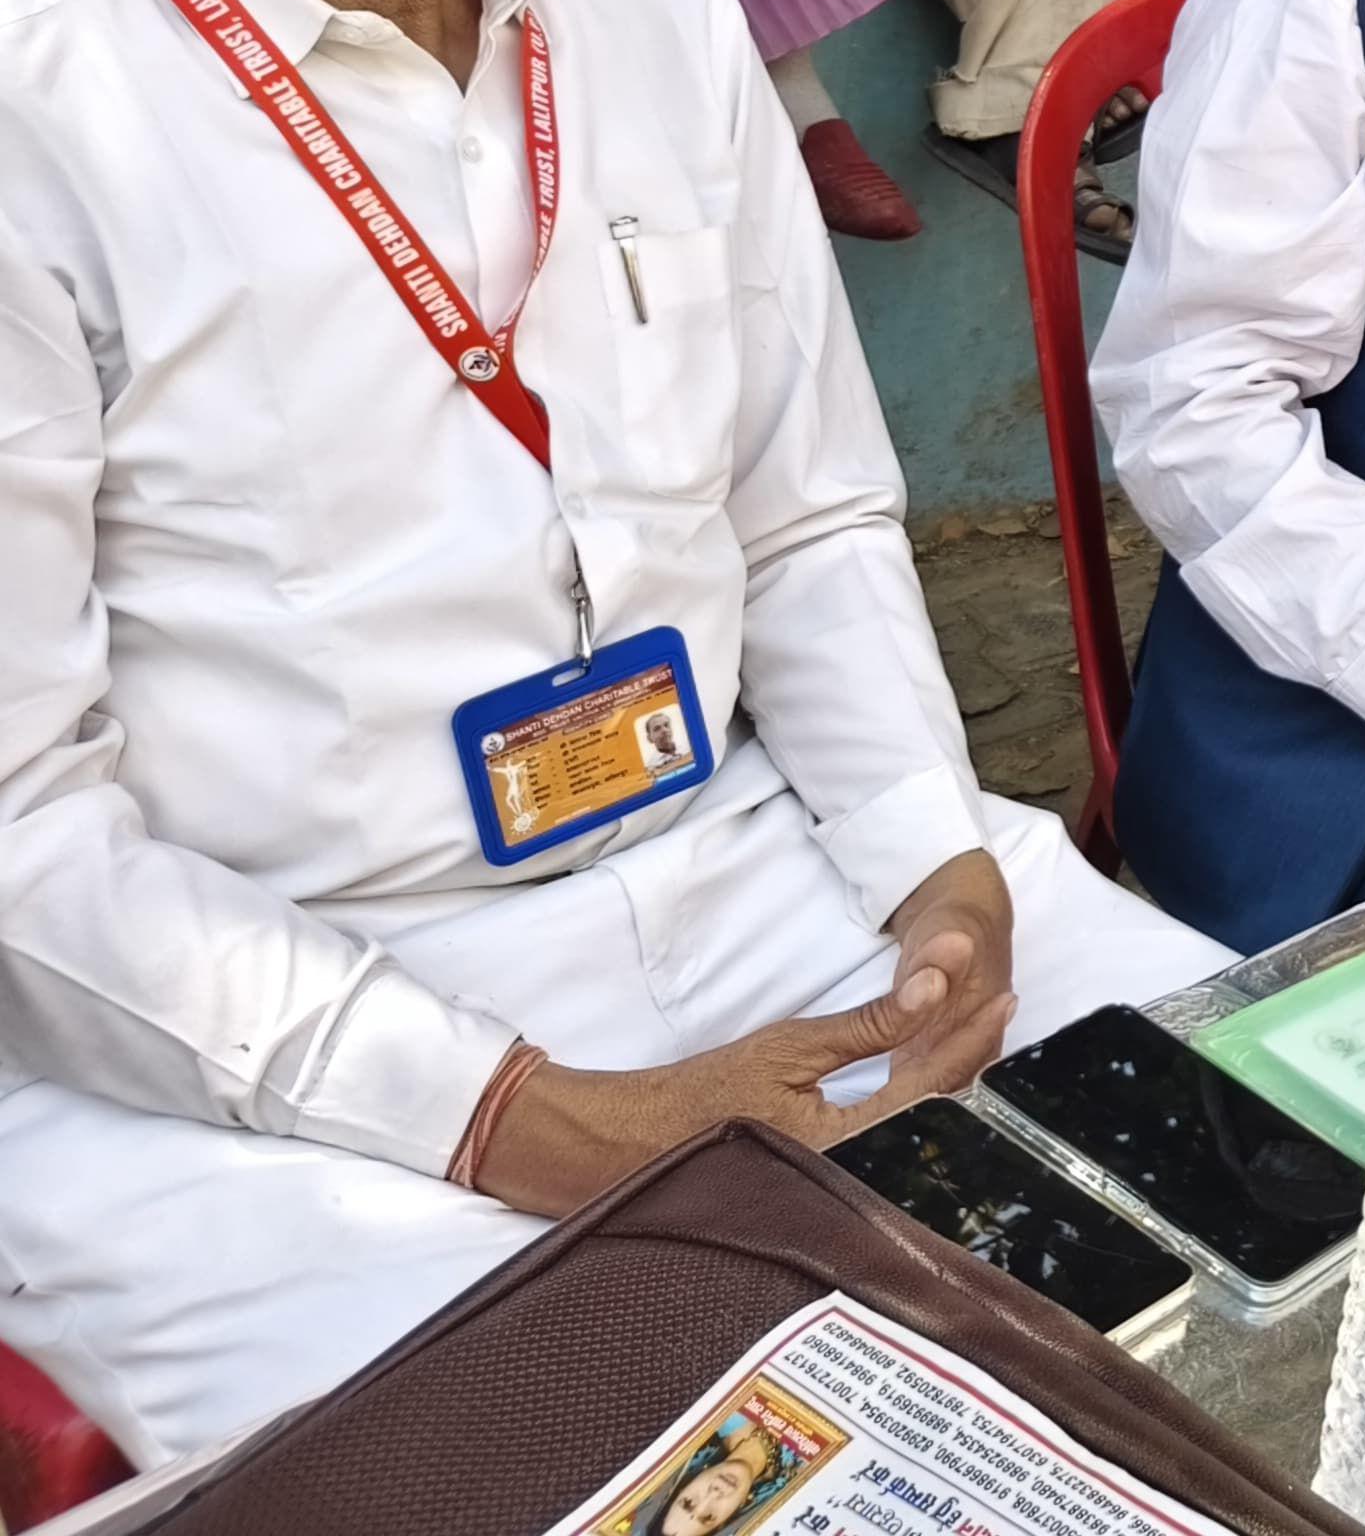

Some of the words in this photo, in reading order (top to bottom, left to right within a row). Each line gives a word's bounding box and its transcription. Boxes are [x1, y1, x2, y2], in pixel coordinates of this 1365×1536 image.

[216, 10, 279, 82] TRUST,
[525, 58, 561, 141] LALITPUR
[263, 71, 363, 194] CHARITABLE
[533, 147, 561, 208] TRUST,
[346, 183, 421, 271] DEHDAN
[401, 261, 470, 341] SHANTI
[504, 719, 541, 742] SHANTI
[583, 680, 641, 711] CHARITABLE
[781, 1345, 862, 1404] 7007276137
[800, 1330, 880, 1388] 9984168060
[820, 1317, 897, 1372] 8090484829
[875, 1378, 954, 1436] 9889936919,
[893, 1362, 972, 1420] 7897820592,
[857, 1396, 936, 1453] 8299203954,
[949, 1424, 1032, 1484] 9889254354,
[967, 1409, 1050, 1470] 6307194753,
[848, 1453, 892, 1493] करें
[877, 1469, 938, 1518] सम्पर्क
[933, 1442, 1013, 1500] 9198667990,
[1047, 1460, 1132, 1521] 9648832375,
[924, 1490, 967, 1536] हेतु
[1027, 1473, 1114, 1536] 9838879480,
